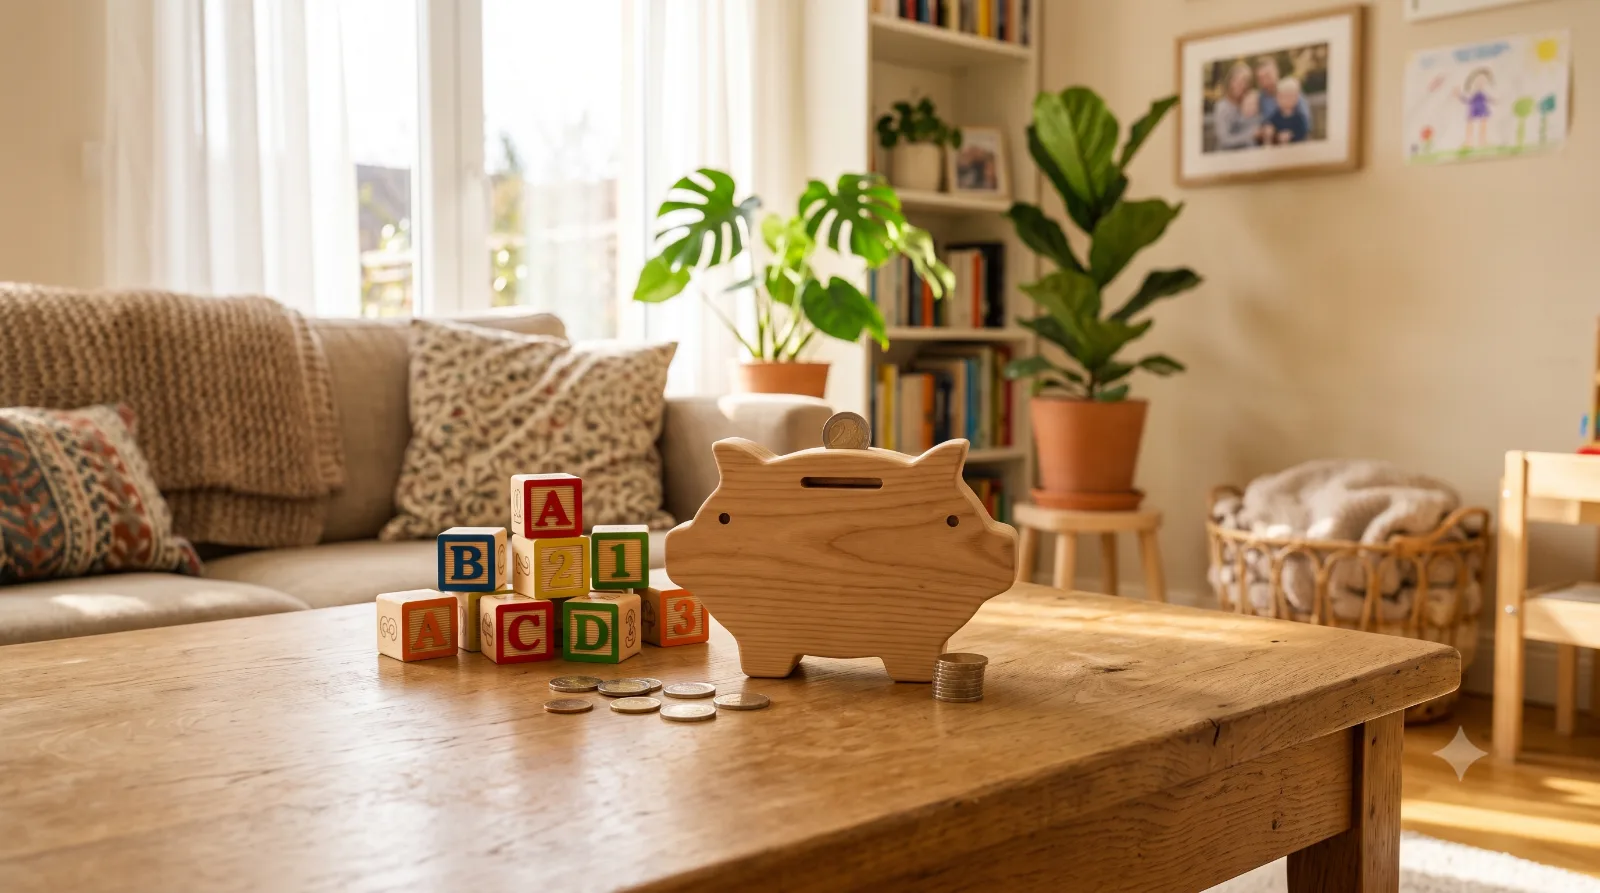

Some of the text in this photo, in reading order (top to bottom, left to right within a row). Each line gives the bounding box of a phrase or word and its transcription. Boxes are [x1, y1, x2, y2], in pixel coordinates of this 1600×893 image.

[535, 490, 573, 527] A
[450, 546, 484, 580] B
[549, 549, 575, 588] 2
[610, 543, 631, 578] 1
[412, 610, 448, 650] A
[508, 614, 541, 651] C
[573, 613, 609, 651] D
[672, 599, 696, 635] 3
